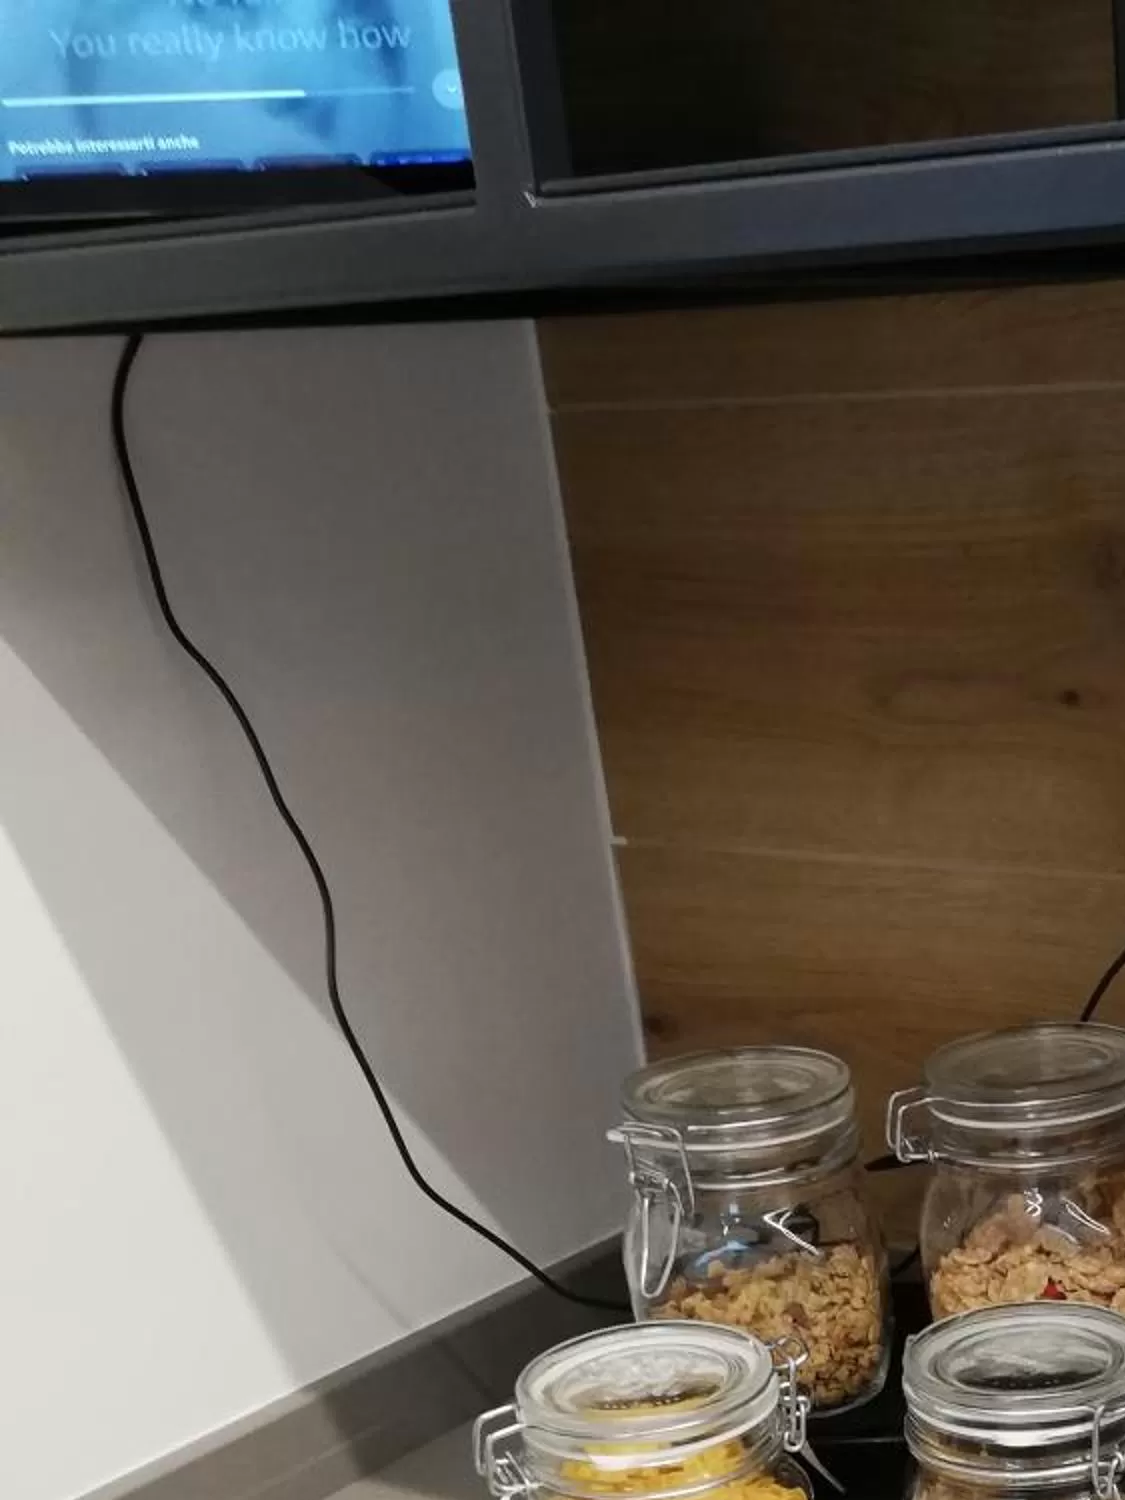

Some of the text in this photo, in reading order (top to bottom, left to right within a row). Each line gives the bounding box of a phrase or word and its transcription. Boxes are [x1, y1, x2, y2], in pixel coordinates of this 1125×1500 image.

[48, 16, 412, 63] You really know how
[157, 134, 201, 150] anche
